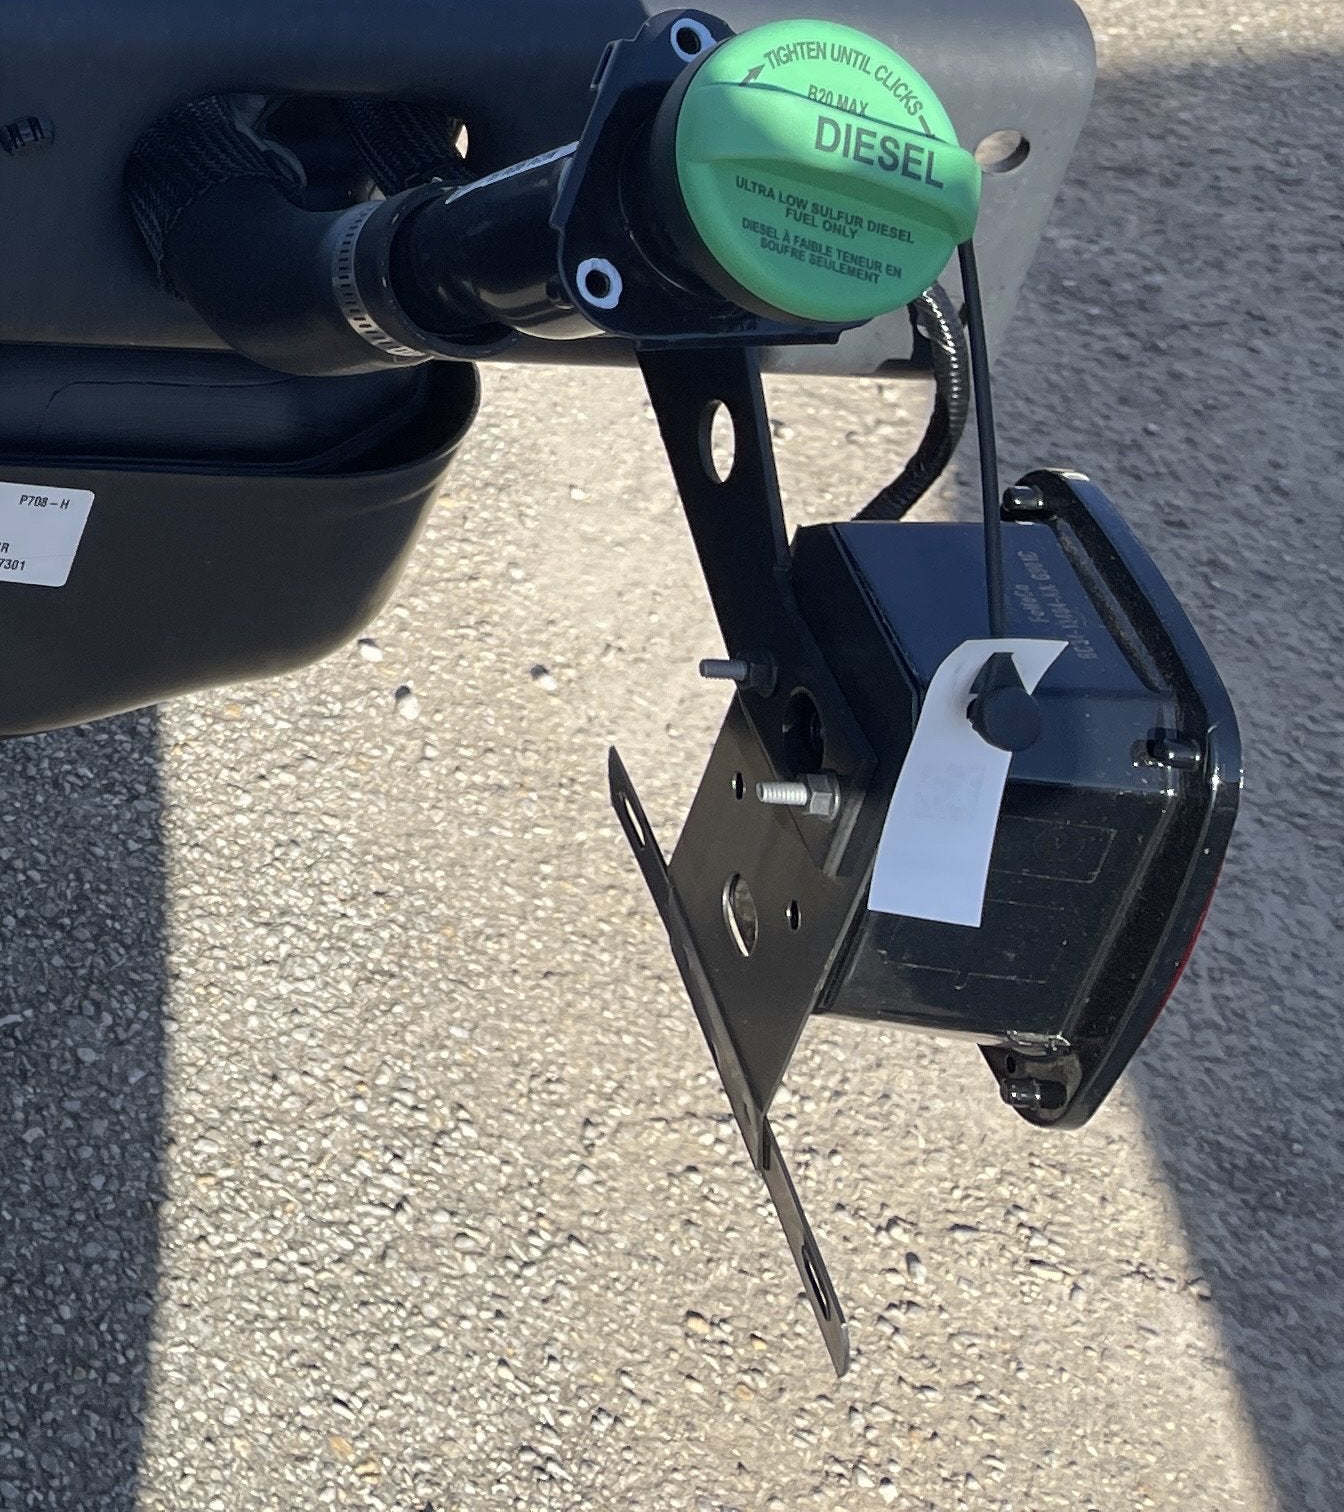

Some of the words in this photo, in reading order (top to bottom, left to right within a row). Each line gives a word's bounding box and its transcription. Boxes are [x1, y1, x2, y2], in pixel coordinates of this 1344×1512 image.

[763, 40, 827, 70] TIGHTEN
[830, 43, 872, 76] UNTIL
[874, 64, 924, 117] CLICKS
[807, 83, 834, 106] B20
[836, 93, 870, 117] MAX
[814, 115, 945, 190] DIESEL
[735, 175, 776, 201] ULTRA
[778, 190, 809, 211] LOW
[811, 202, 864, 230] SULFUR
[867, 219, 915, 245] DIESEL
[785, 207, 819, 229] FUEL
[821, 219, 859, 241] ONLY
[741, 216, 781, 241] DIESEL
[782, 228, 793, 243] À
[793, 234, 834, 259] FAIBLE
[836, 247, 883, 274] TENEUR
[885, 263, 903, 280] EN
[760, 237, 807, 263] SOUFRE
[808, 252, 881, 286] SEULEMENT
